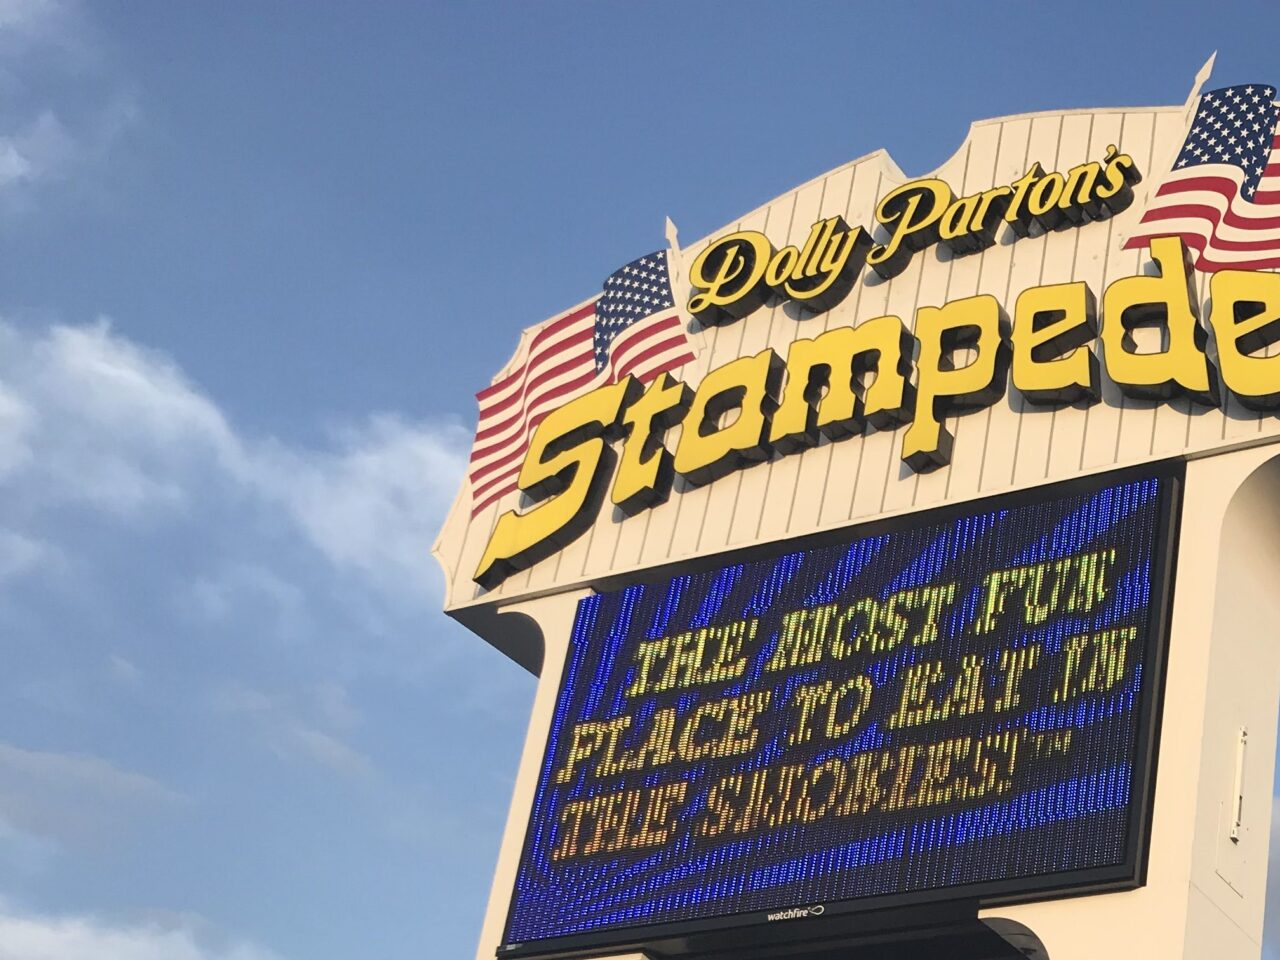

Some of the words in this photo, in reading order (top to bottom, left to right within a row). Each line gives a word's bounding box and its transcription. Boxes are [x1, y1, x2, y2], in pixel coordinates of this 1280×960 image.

[686, 214, 868, 318] Dolly
[865, 143, 1138, 272] Parton's
[626, 620, 758, 697] THE
[765, 582, 956, 672] MOST
[973, 549, 1117, 636] FUN
[556, 691, 771, 784] PLACE
[789, 673, 872, 745] TO
[889, 643, 1040, 729] EAT
[1053, 627, 1138, 702] IN
[553, 782, 688, 861] THE
[767, 907, 809, 921] watchfire
